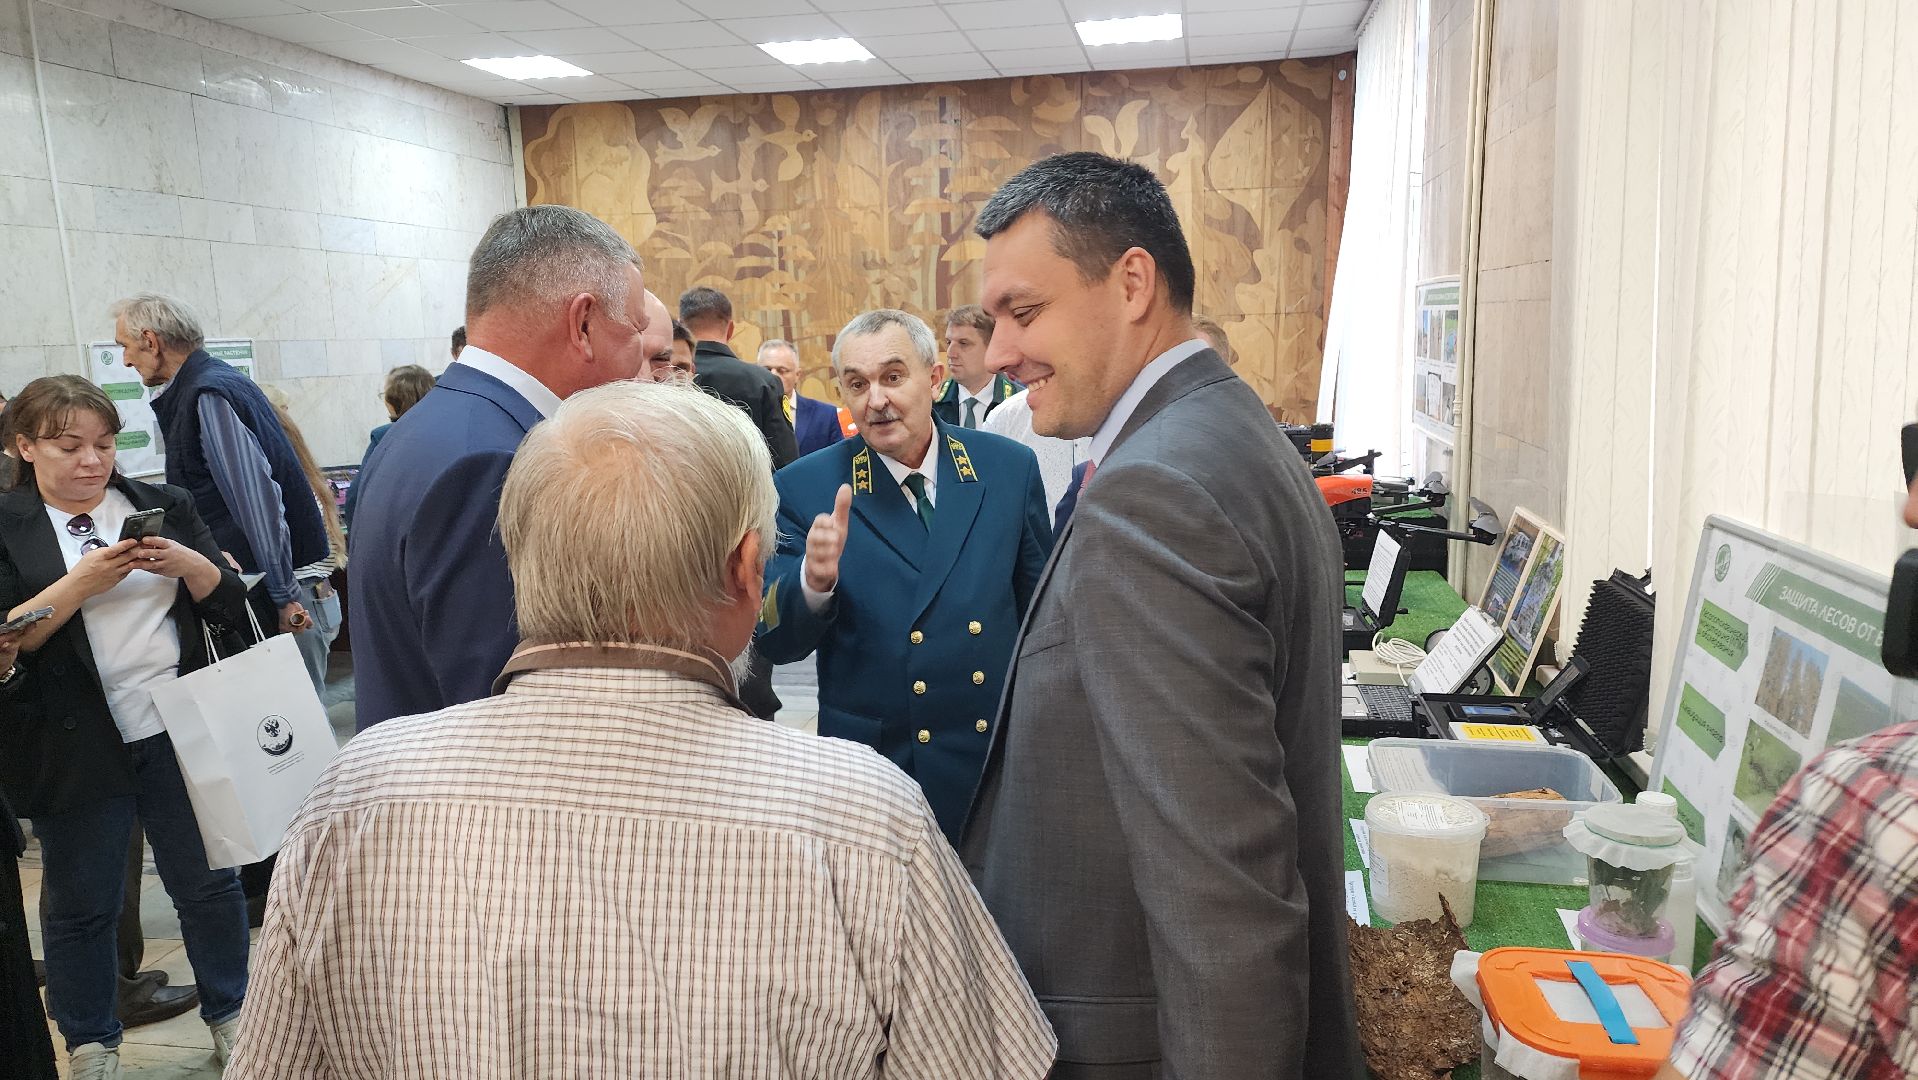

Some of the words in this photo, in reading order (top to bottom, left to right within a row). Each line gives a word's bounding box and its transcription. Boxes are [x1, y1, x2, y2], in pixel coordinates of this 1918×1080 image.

[1779, 585, 1820, 616] ЗАЩИТА
[1818, 604, 1857, 634] ЛЕСОВ
[1857, 622, 1876, 642] ОТ
